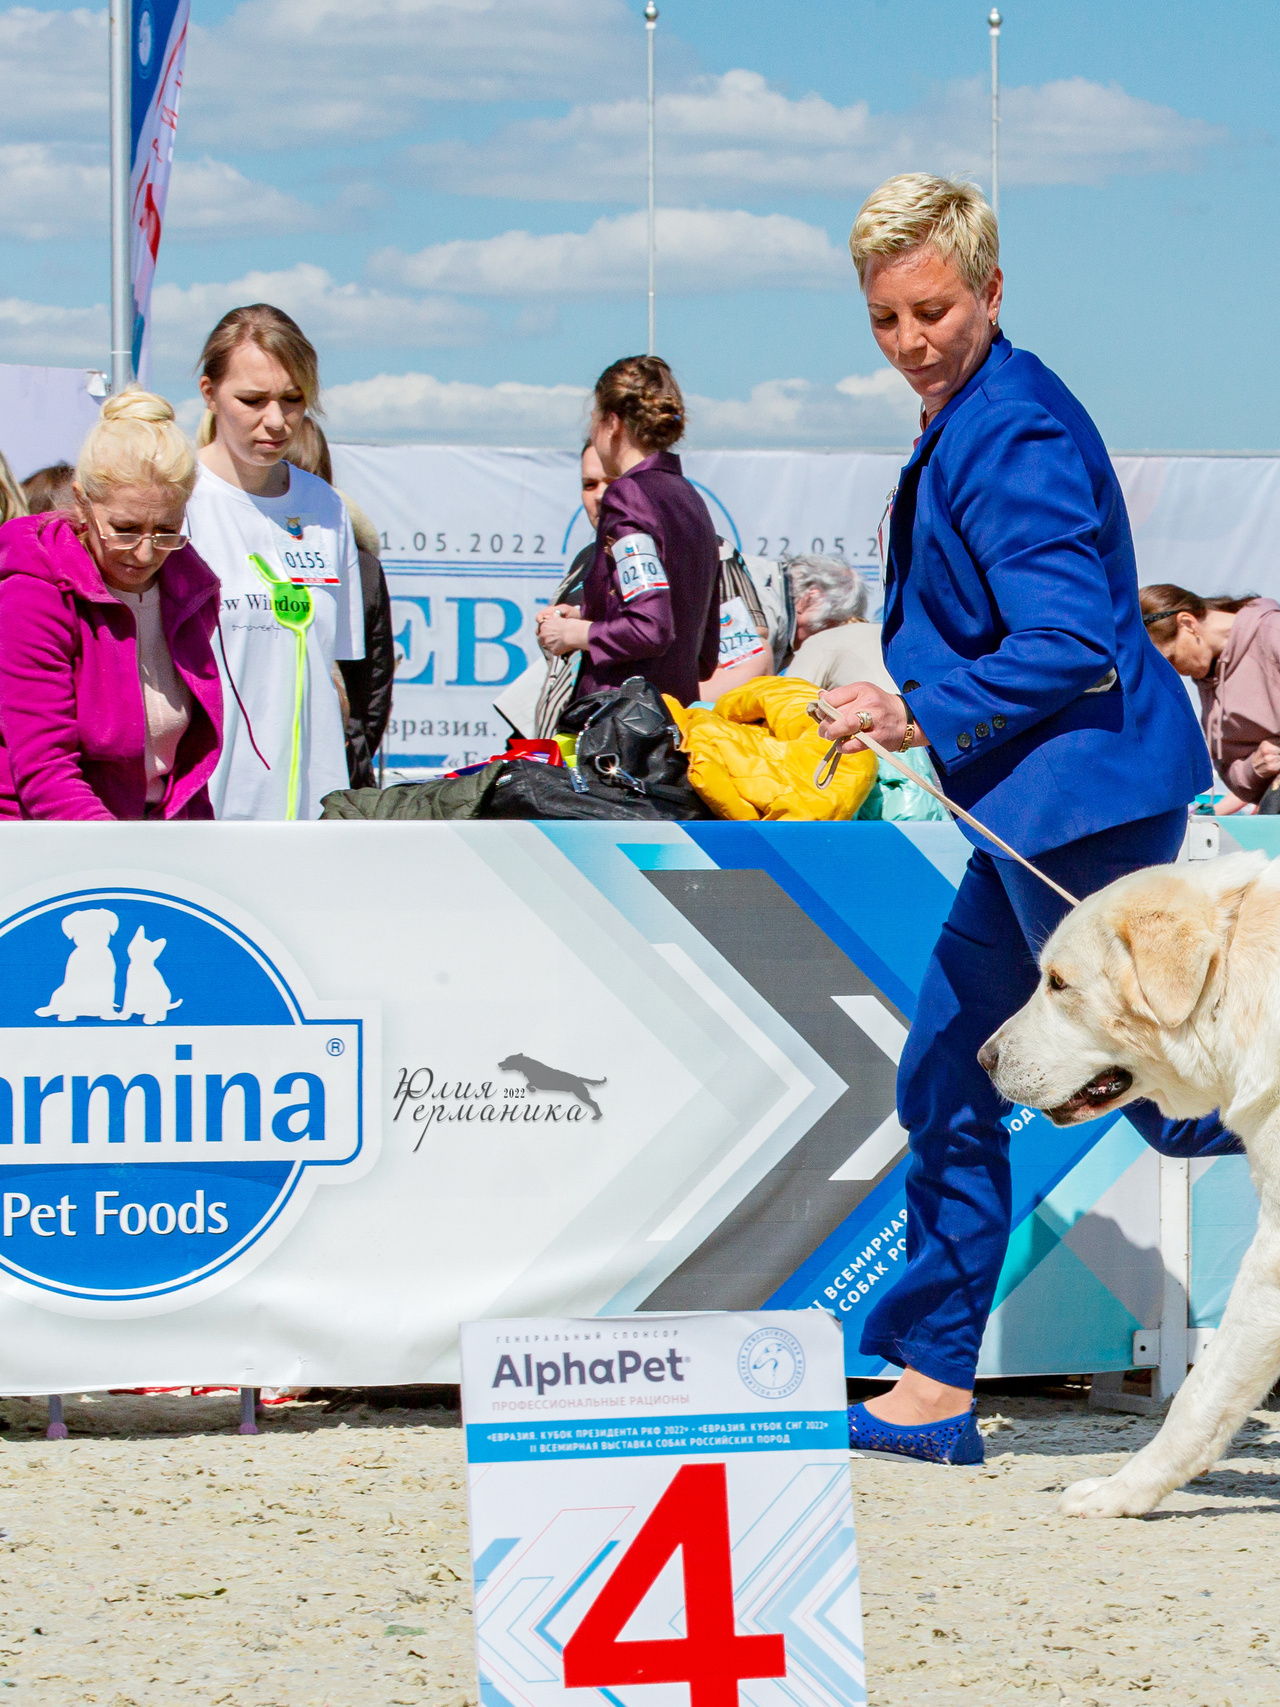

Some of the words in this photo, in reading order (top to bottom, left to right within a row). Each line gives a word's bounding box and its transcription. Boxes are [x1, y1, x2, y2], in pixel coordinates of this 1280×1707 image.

[285, 551, 325, 569] 0155
[245, 594, 311, 613] Window
[389, 595, 549, 687] ЕВ
[0, 1043, 326, 1145] rmina
[393, 1067, 498, 1100] Юлия
[503, 1087, 526, 1099] 2022
[2, 1191, 78, 1237] Pet
[95, 1189, 230, 1236] Foods
[823, 1208, 908, 1300] ВСЕМИРНАЯ
[838, 1261, 889, 1312] СОБАК
[495, 1331, 602, 1344] ГЕНЕРАЛЬНЫЙ
[612, 1329, 679, 1340] СПОНСОР
[491, 1348, 686, 1396] AlphaPet
[492, 1396, 627, 1412] ПРОФЕССИОНАЛЬНЫЕ
[629, 1394, 691, 1407] РАЦИОНЫ
[539, 1441, 599, 1453] ВСЕМИРНАЯ
[601, 1439, 653, 1450] ВЫСТАВКА
[655, 1438, 687, 1448] СОБАК
[689, 1435, 754, 1447] РОССИЙСКИХ
[756, 1434, 791, 1444] ПОРОД
[540, 1430, 573, 1440] КУБОК
[575, 1427, 638, 1439] ПРЕЗИДЕНТА
[641, 1426, 662, 1436] РКФ
[750, 1422, 782, 1432] КУБОК
[785, 1421, 803, 1431] СНГ
[562, 1462, 787, 1707] 4
